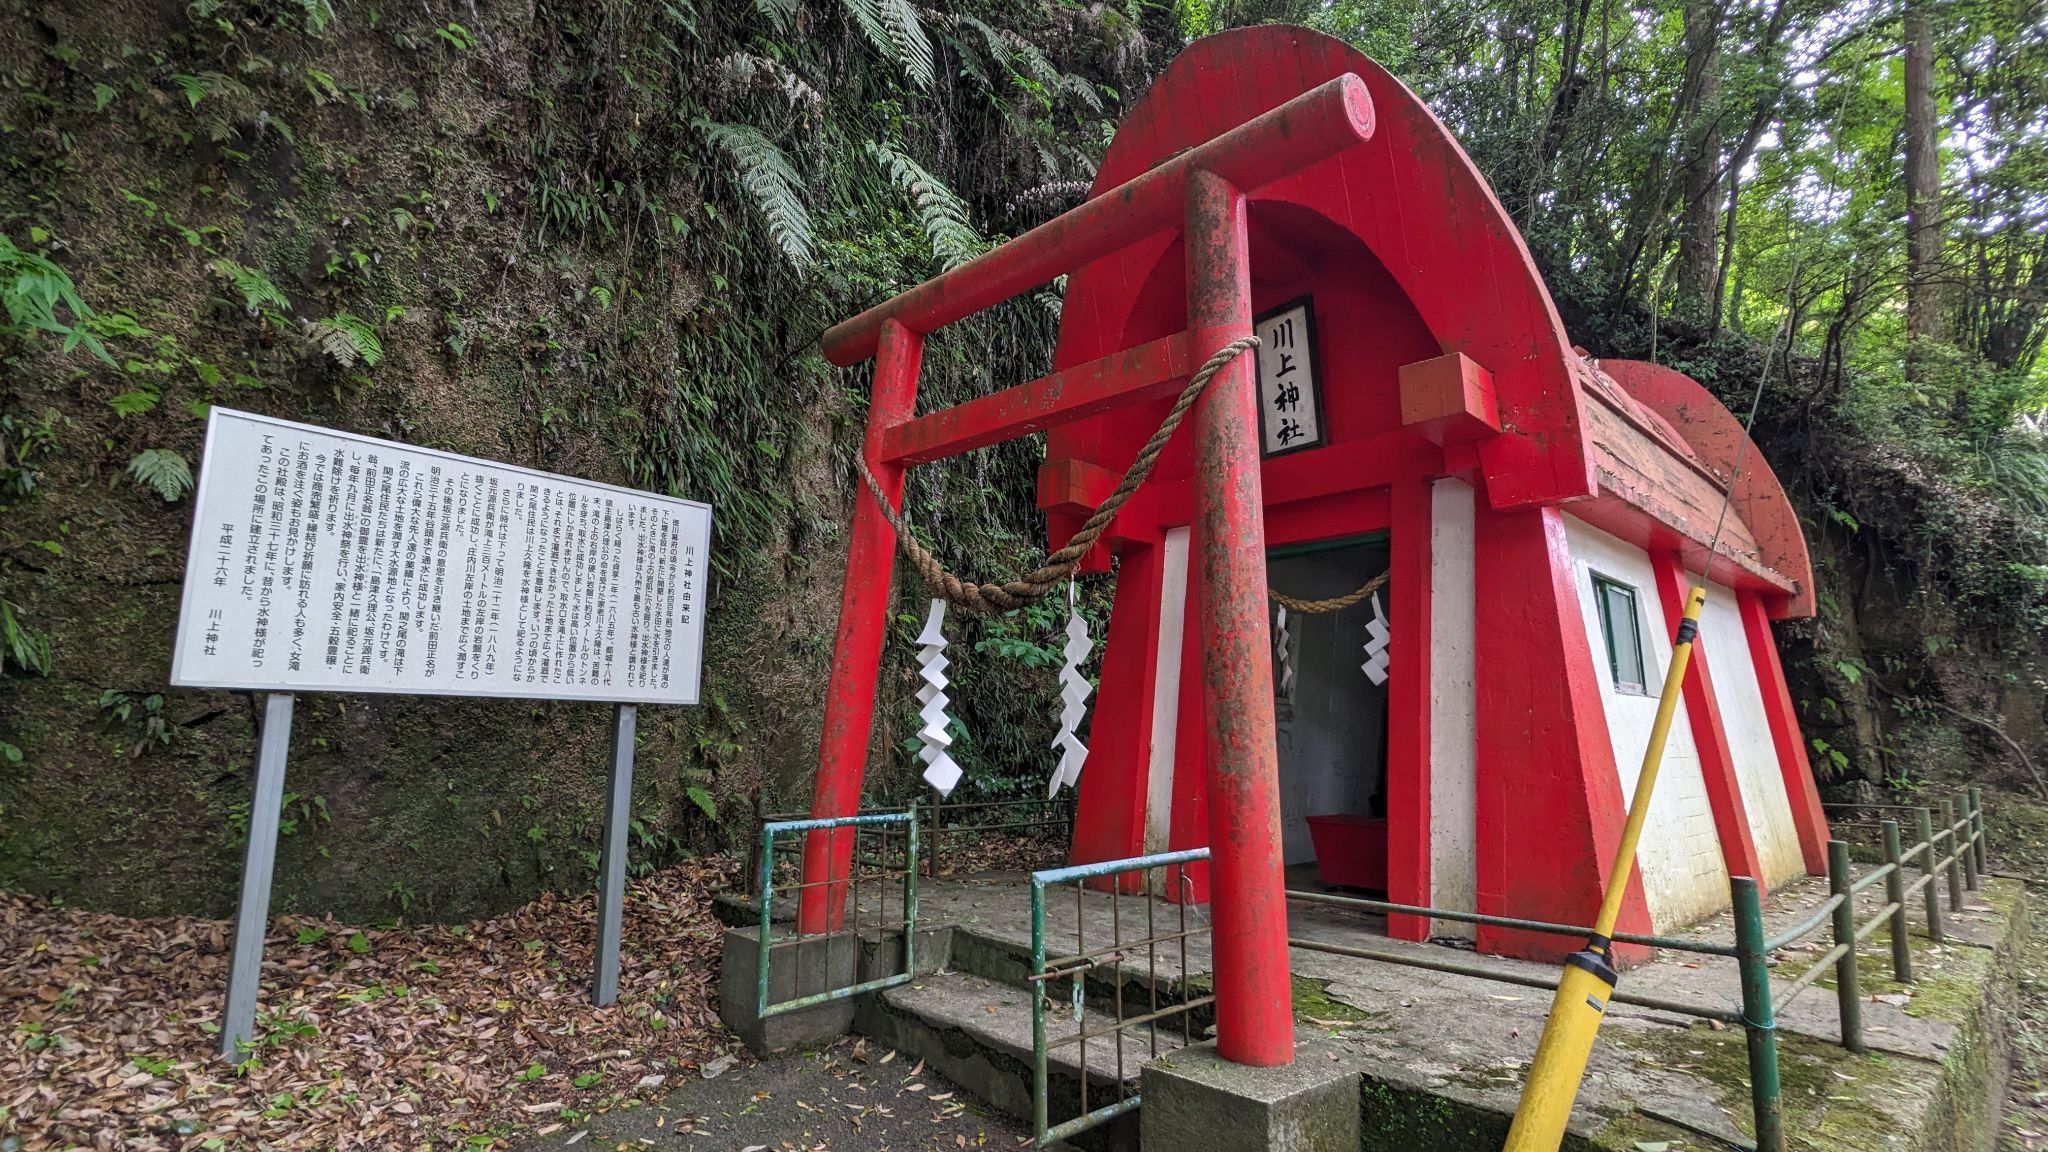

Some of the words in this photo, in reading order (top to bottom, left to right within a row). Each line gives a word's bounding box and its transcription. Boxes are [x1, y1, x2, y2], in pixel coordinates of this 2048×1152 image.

[1273, 318, 1304, 446] 川上神社
[213, 522, 234, 587] 平成二十六年
[240, 434, 274, 600] てあったこの場所に建立されました。
[250, 447, 290, 667] この社殿は、昭和三十七年に、昔から水神様が祀っ
[280, 440, 313, 590] にお酒を注ぐ姿もお見かけします。
[324, 448, 345, 536] 水難除けを祈ります。
[378, 459, 410, 662] 流の広大な土地を潤す大水源地となったわけです。
[413, 465, 441, 632] 明治三十五年谷頭まで通水に成功します。
[454, 471, 470, 537] とになりました。
[513, 482, 524, 520] りました。
[627, 503, 636, 530] います。
[203, 608, 222, 655] 川上神社
[392, 472, 424, 676] これら偉大な先人達の業績により、関之尾の滝は下
[455, 474, 484, 679] 抜くことに成功し、庄内川左岸の土地まで広く潤すこ
[470, 476, 499, 679] 坂元源兵衛が滝上三百メートルの左岸の岩盤をくり
[525, 487, 551, 682] きるようになったことを意味します。いつの頃からか
[680, 545, 694, 624] 川上神社由来記
